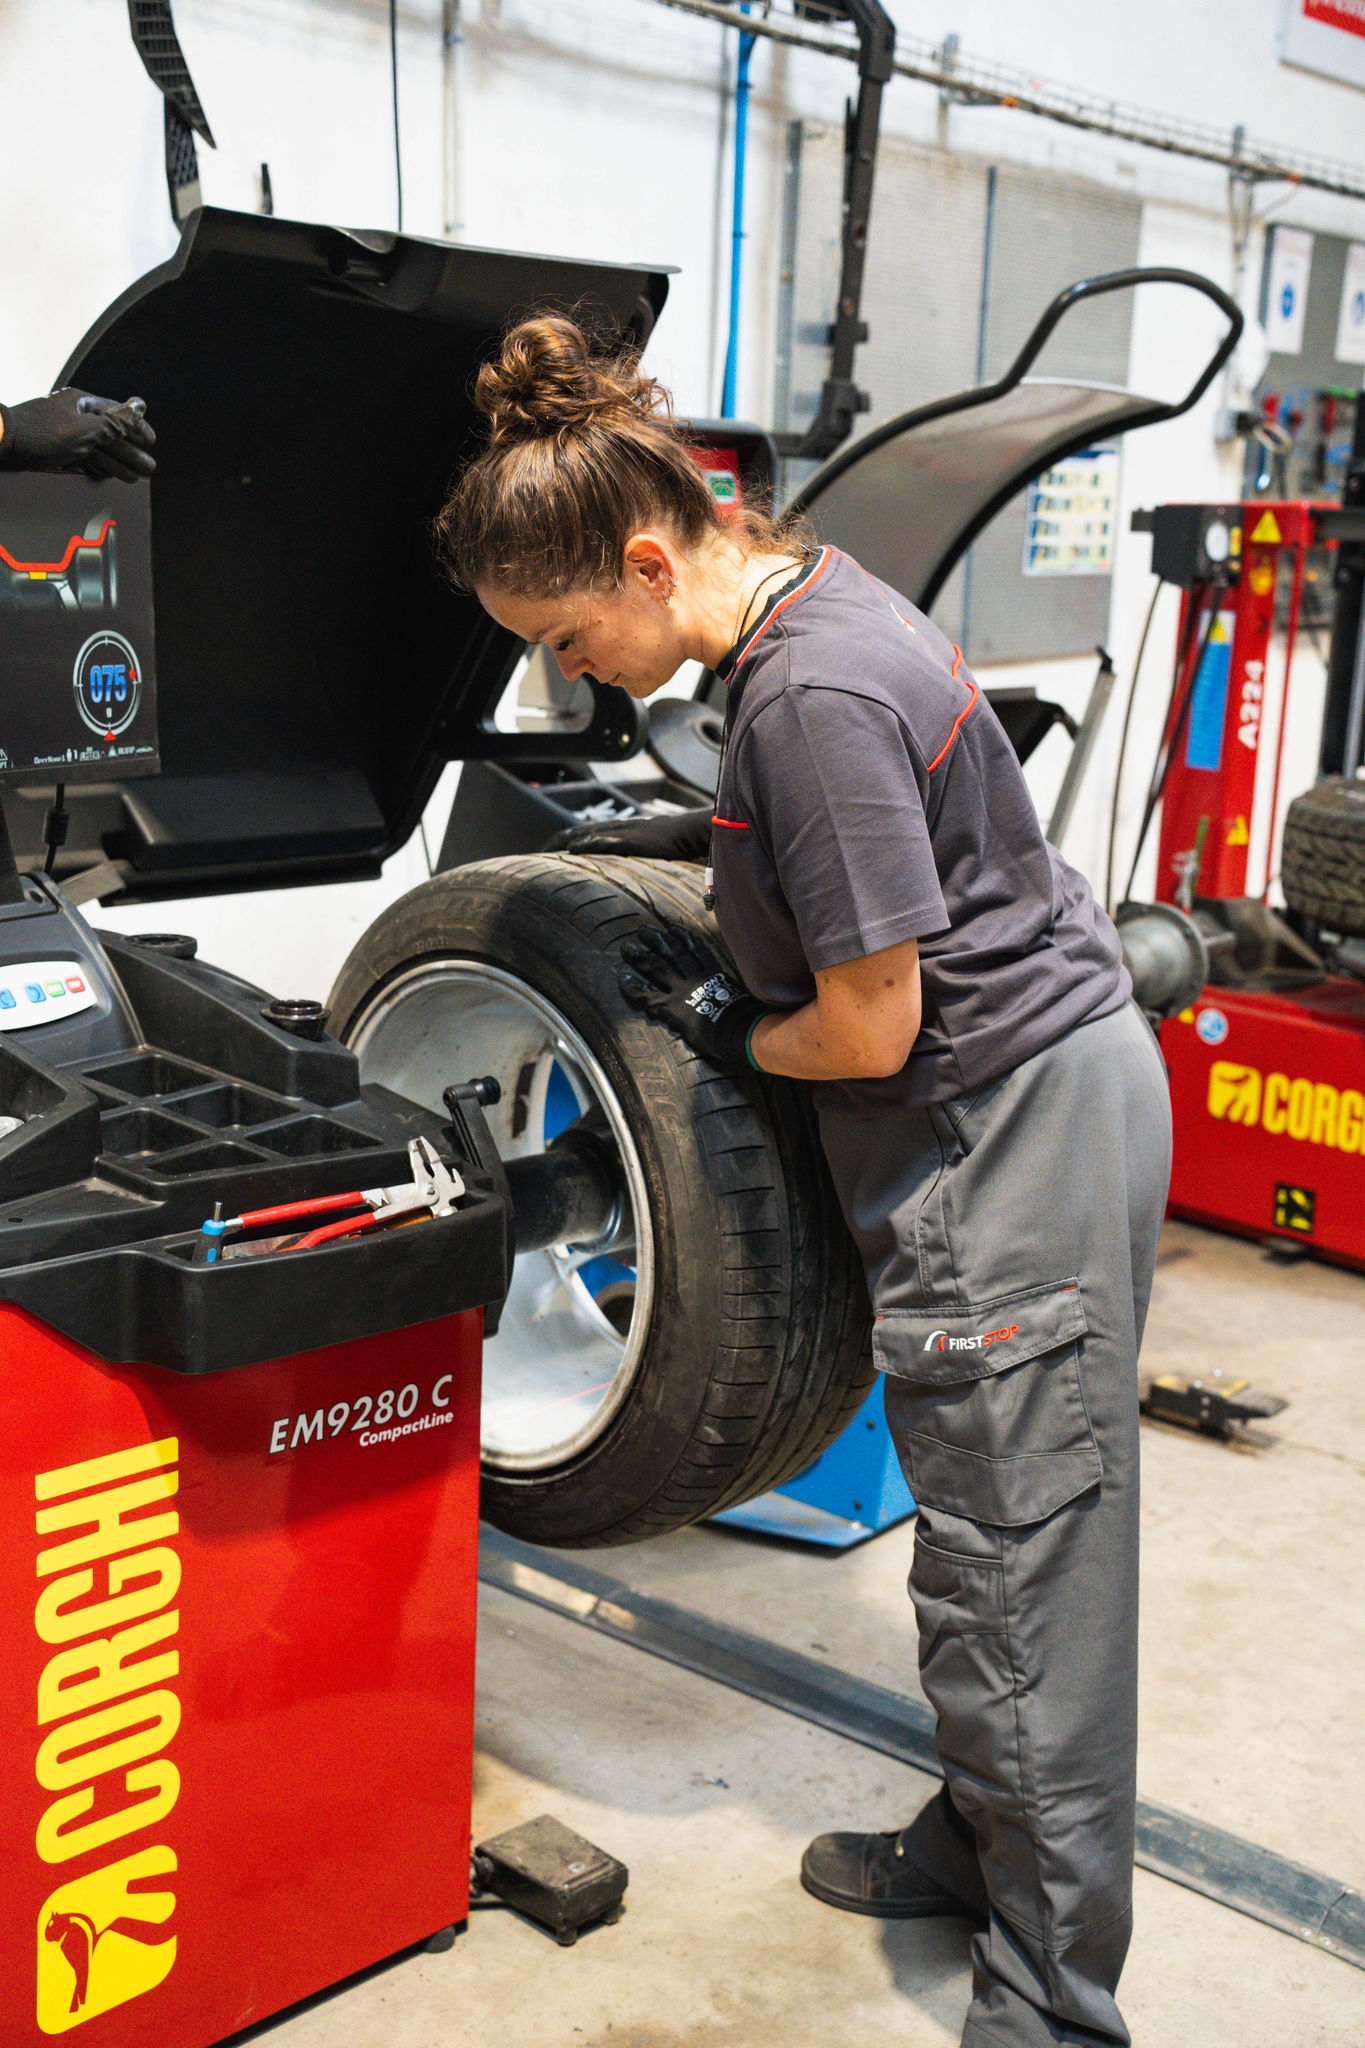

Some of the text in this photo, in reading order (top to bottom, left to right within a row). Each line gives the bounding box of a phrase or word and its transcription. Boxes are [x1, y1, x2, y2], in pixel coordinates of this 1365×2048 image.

[90, 665, 126, 703] 075
[1238, 660, 1264, 750] A224
[1263, 1072, 1365, 1157] CORG
[269, 1373, 454, 1455] EM9280 C
[359, 1411, 454, 1447] CompactLine
[35, 1436, 182, 1865] CORGHI
